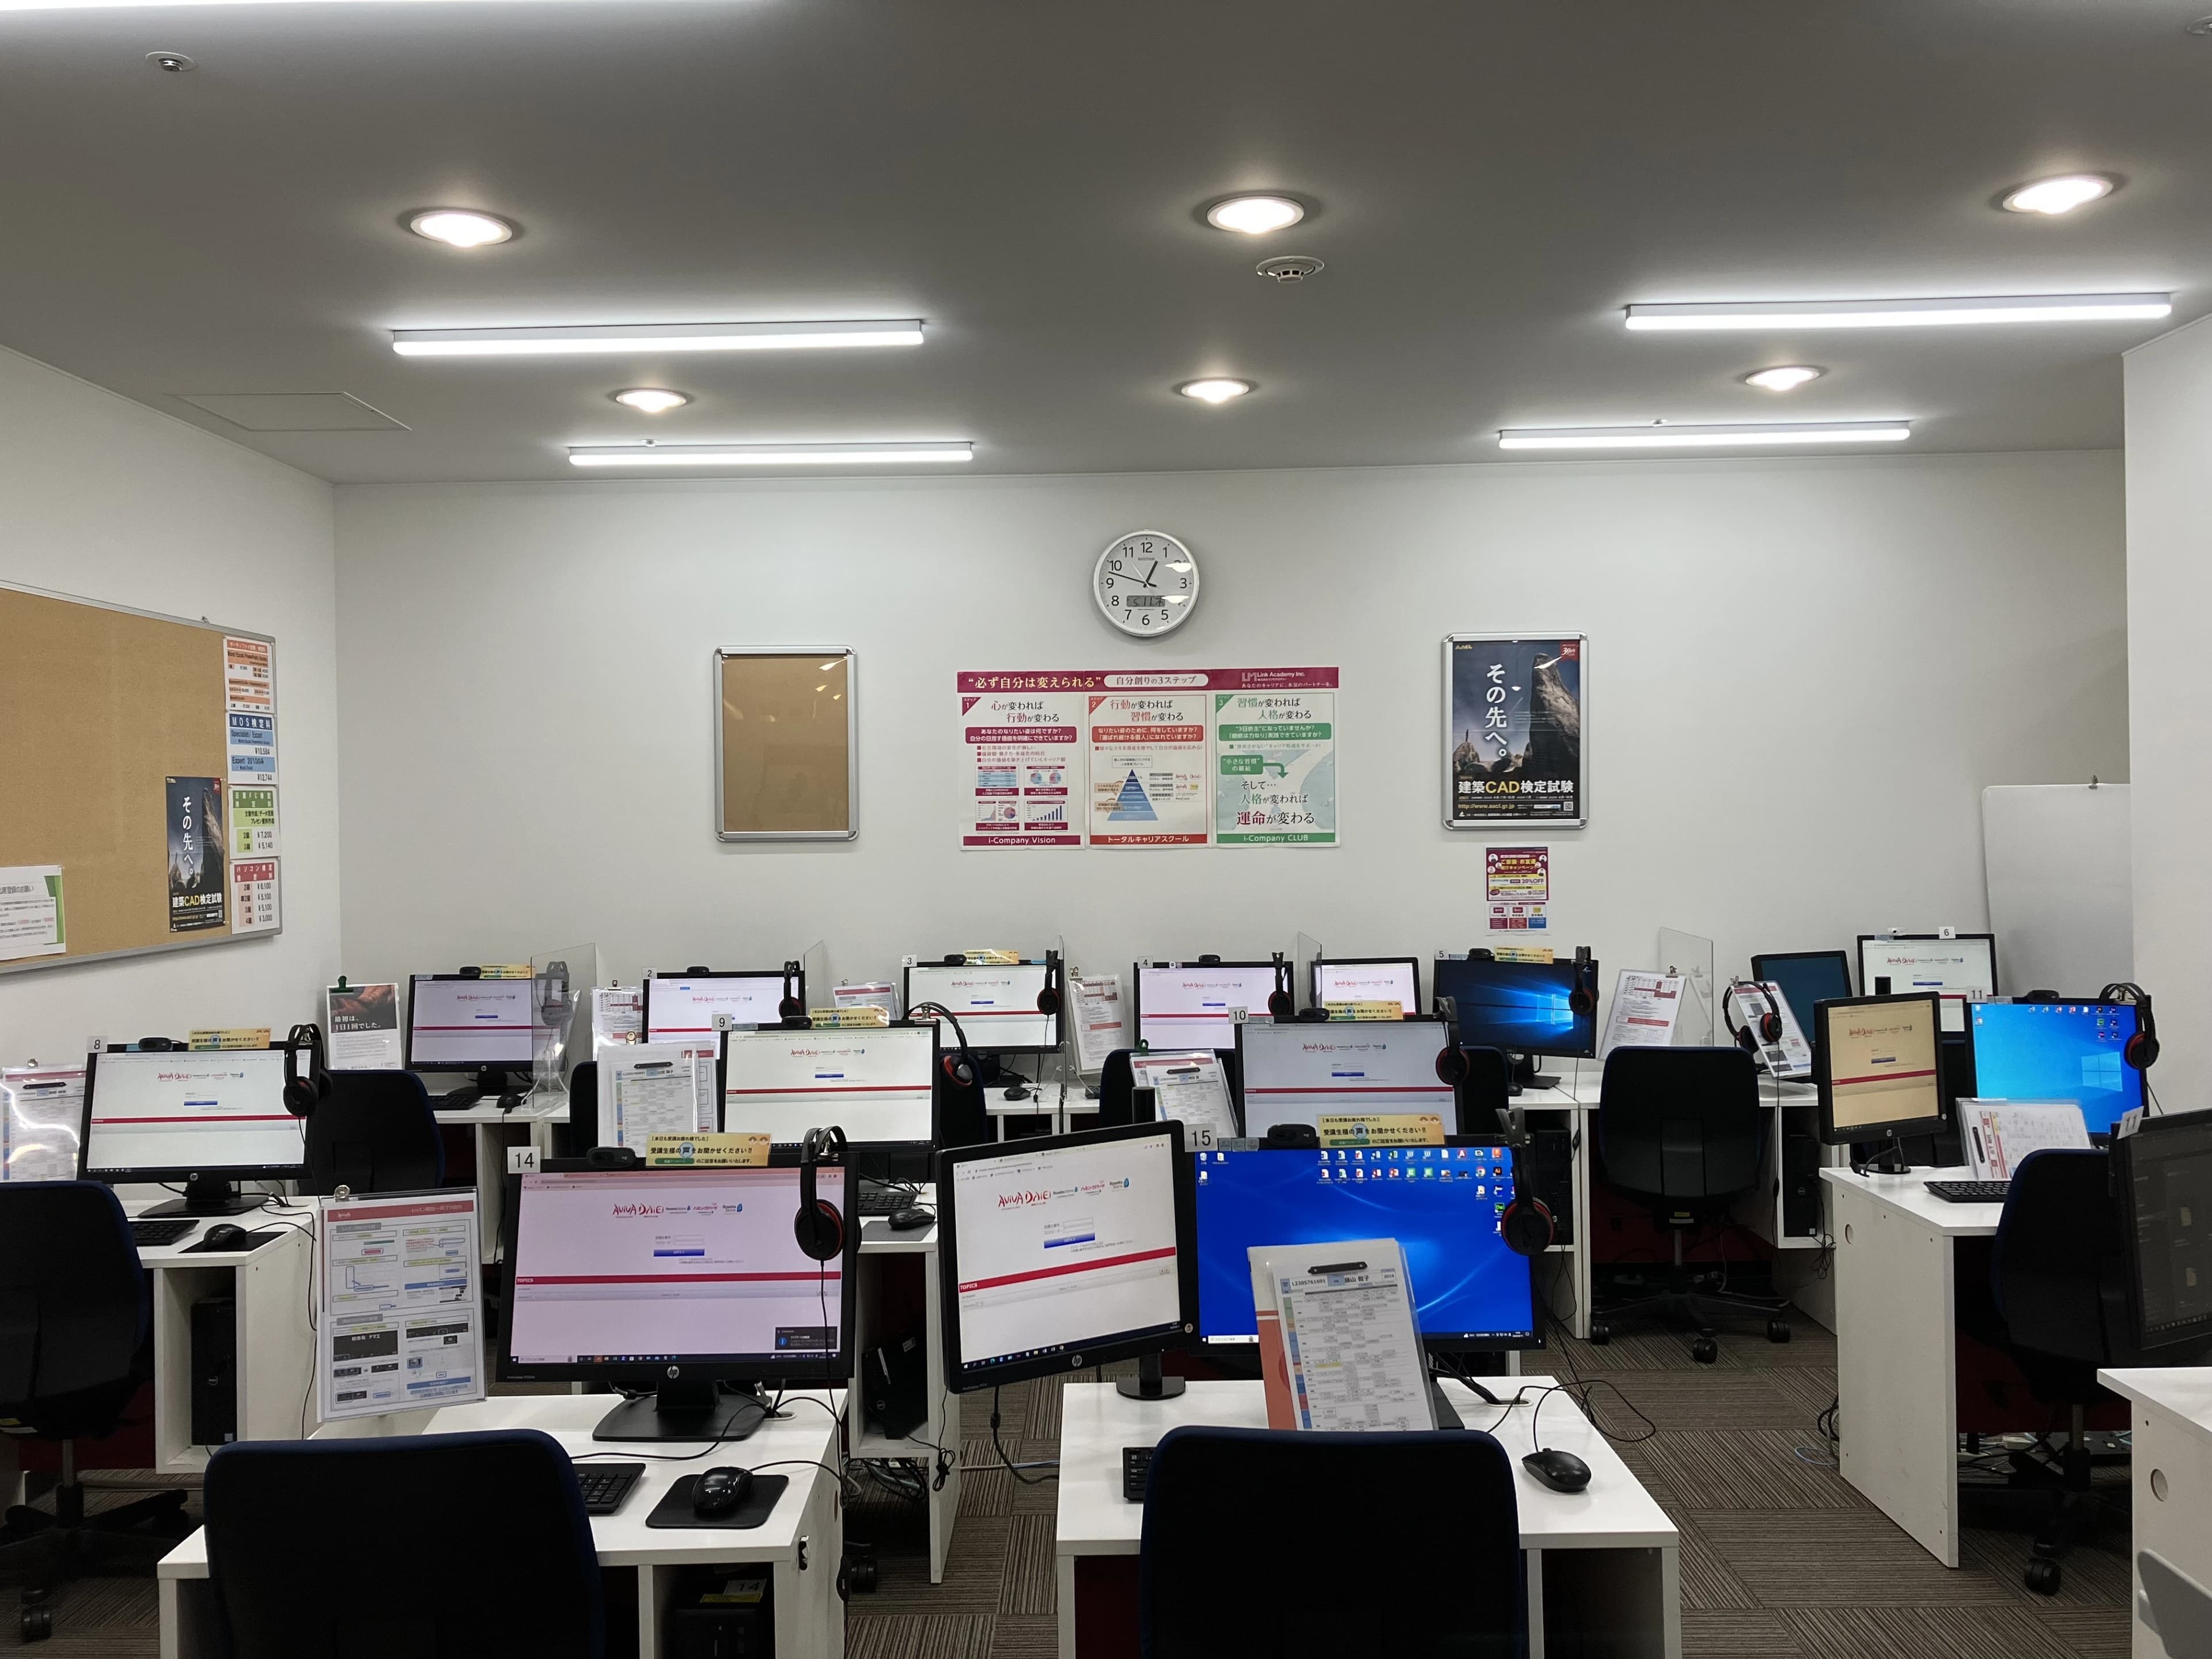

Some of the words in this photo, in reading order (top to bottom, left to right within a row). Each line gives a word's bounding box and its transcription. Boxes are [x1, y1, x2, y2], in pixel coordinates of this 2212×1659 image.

[1123, 547, 1133, 558] 11
[1141, 542, 1153, 553] 12
[1162, 547, 1167, 558] 1
[1109, 560, 1122, 571] 10
[1106, 578, 1114, 588] 9
[1180, 578, 1187, 588] 3
[1111, 595, 1119, 606] 8
[1124, 609, 1132, 620] 7
[1142, 615, 1150, 625] 6
[1161, 609, 1168, 620] 5
[1116, 675, 1197, 685] 自分創りの3ステップ
[991, 700, 1044, 711] 心が変われば
[1110, 699, 1173, 710] 行動が変われば
[1237, 698, 1301, 708] 習慣が変われば
[1258, 709, 1312, 720] 人格が変わる
[1484, 663, 1508, 758] その先へ。
[1006, 713, 1059, 723] 行動が変わる
[1130, 711, 1184, 722] 習慣が変わる
[1458, 780, 1574, 794] 建築CAD検定試験
[1241, 793, 1308, 805] 人格が変われば
[1237, 810, 1315, 825] 運命が変わる
[182, 796, 194, 875] その先へ。
[988, 836, 1029, 845] i-Company
[1244, 835, 1285, 843] i-Company
[172, 892, 222, 908] 建築CAD検定試験
[1971, 989, 1983, 999] 11
[1233, 1010, 1246, 1020] 10
[335, 1022, 381, 1031] 1日1回でした。
[719, 1017, 725, 1028] 9
[94, 1039, 100, 1050] 8
[2124, 1113, 2137, 1132] 11
[1191, 1130, 1211, 1146] 15
[515, 1152, 535, 1168] 14
[738, 1582, 760, 1592] 14
